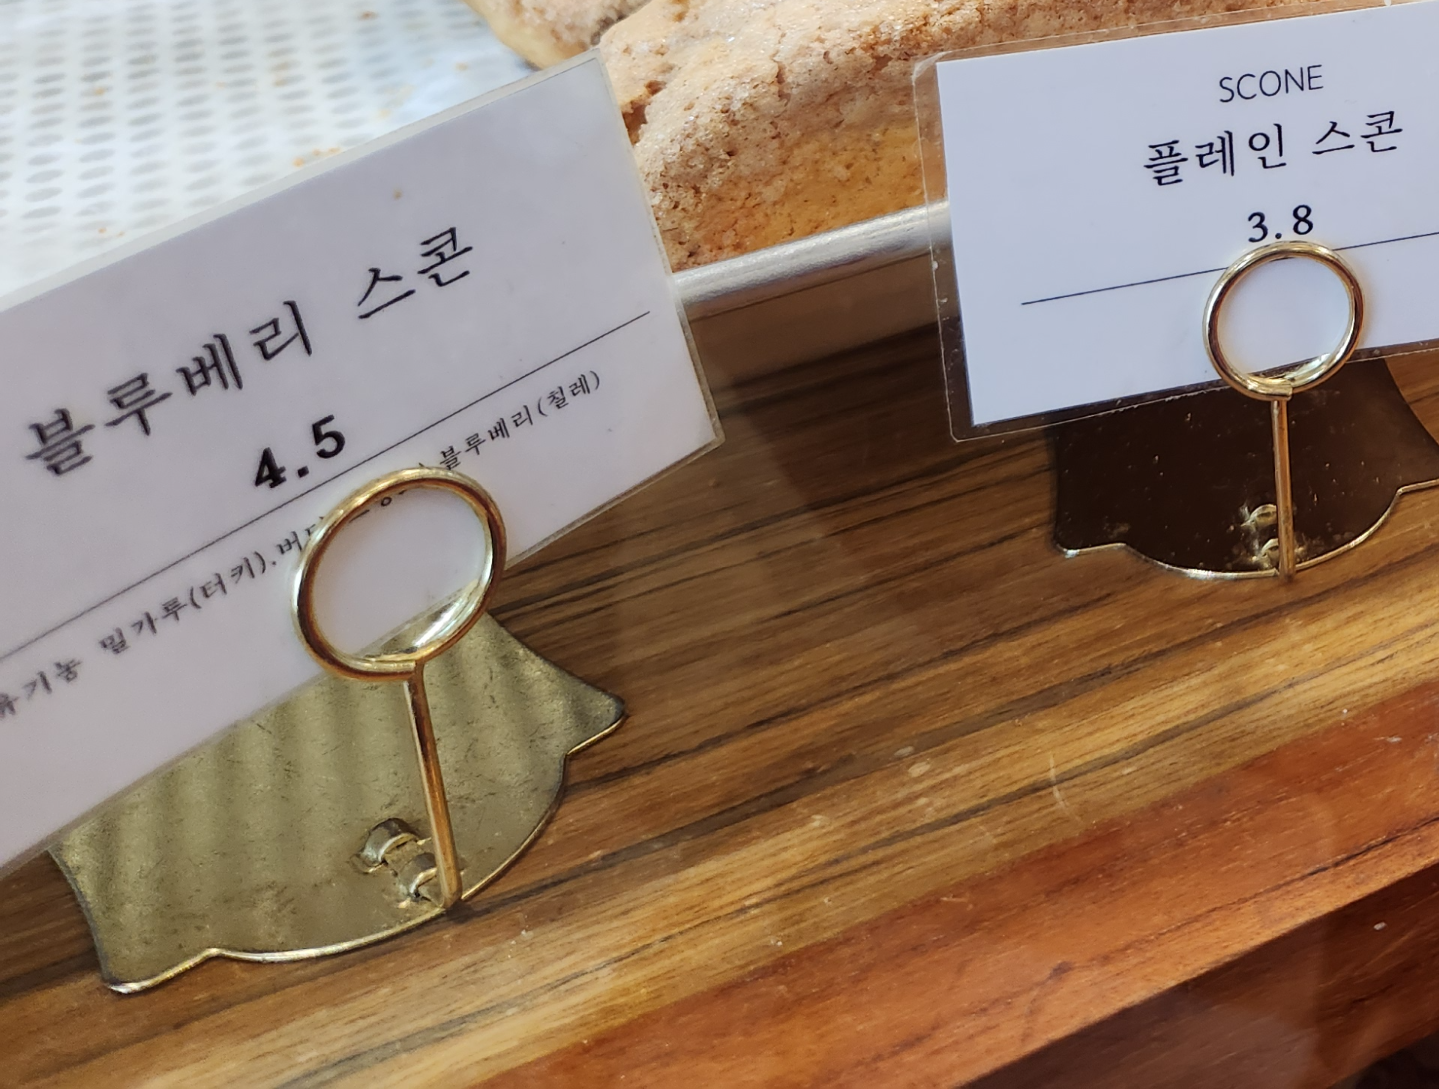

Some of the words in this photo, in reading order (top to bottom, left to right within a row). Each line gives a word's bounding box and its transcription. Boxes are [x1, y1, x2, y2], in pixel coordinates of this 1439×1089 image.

[1218, 64, 1324, 103] SCONE
[1143, 123, 1288, 186] 플레인
[1311, 110, 1403, 156] 스콘
[1247, 204, 1314, 244] 3.8
[24, 300, 315, 475] 블루베리
[356, 226, 474, 320] 스콘
[254, 414, 346, 489] 4.5
